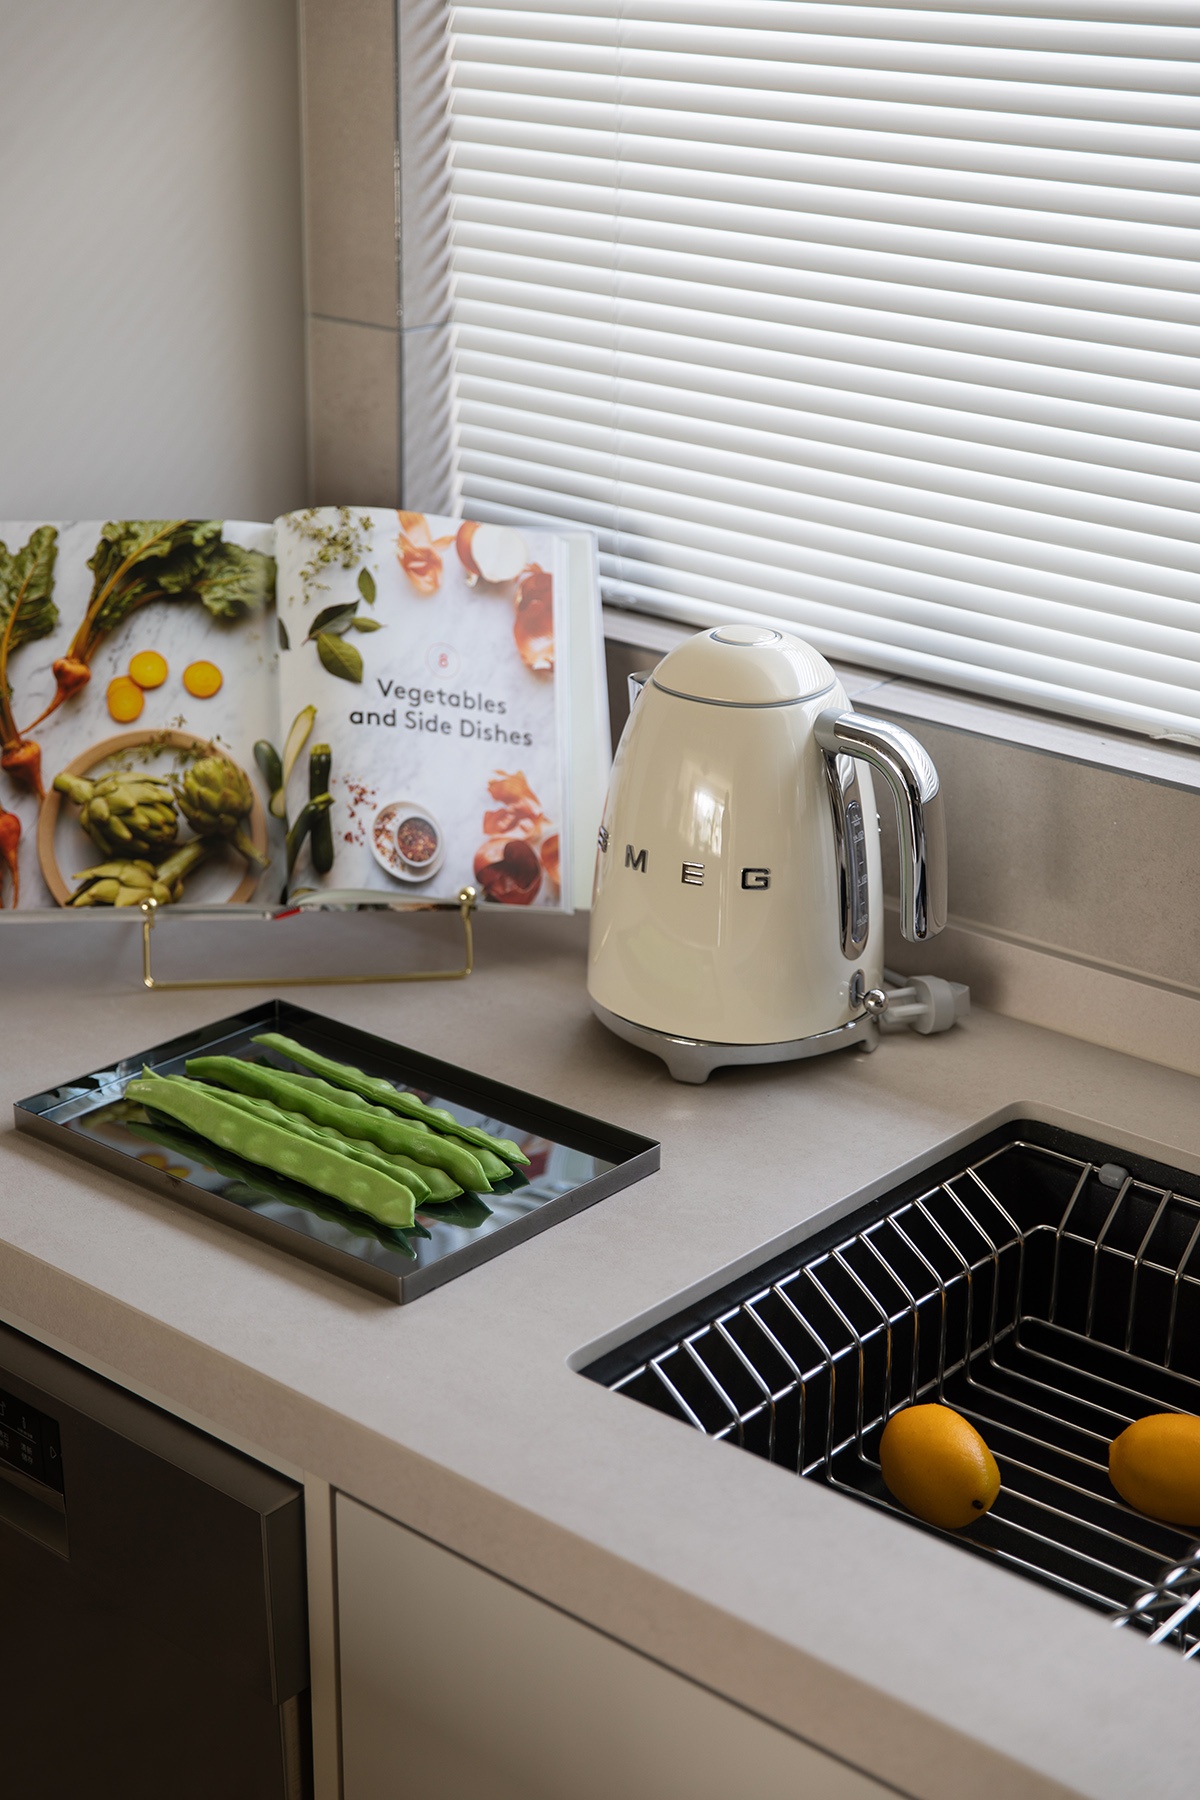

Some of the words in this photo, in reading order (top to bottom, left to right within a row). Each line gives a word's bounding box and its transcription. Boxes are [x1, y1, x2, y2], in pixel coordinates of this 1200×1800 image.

[437, 652, 449, 668] 8
[377, 678, 507, 715] Vegetables
[349, 709, 397, 727] and
[405, 710, 452, 735] Side
[460, 719, 533, 747] Dishes
